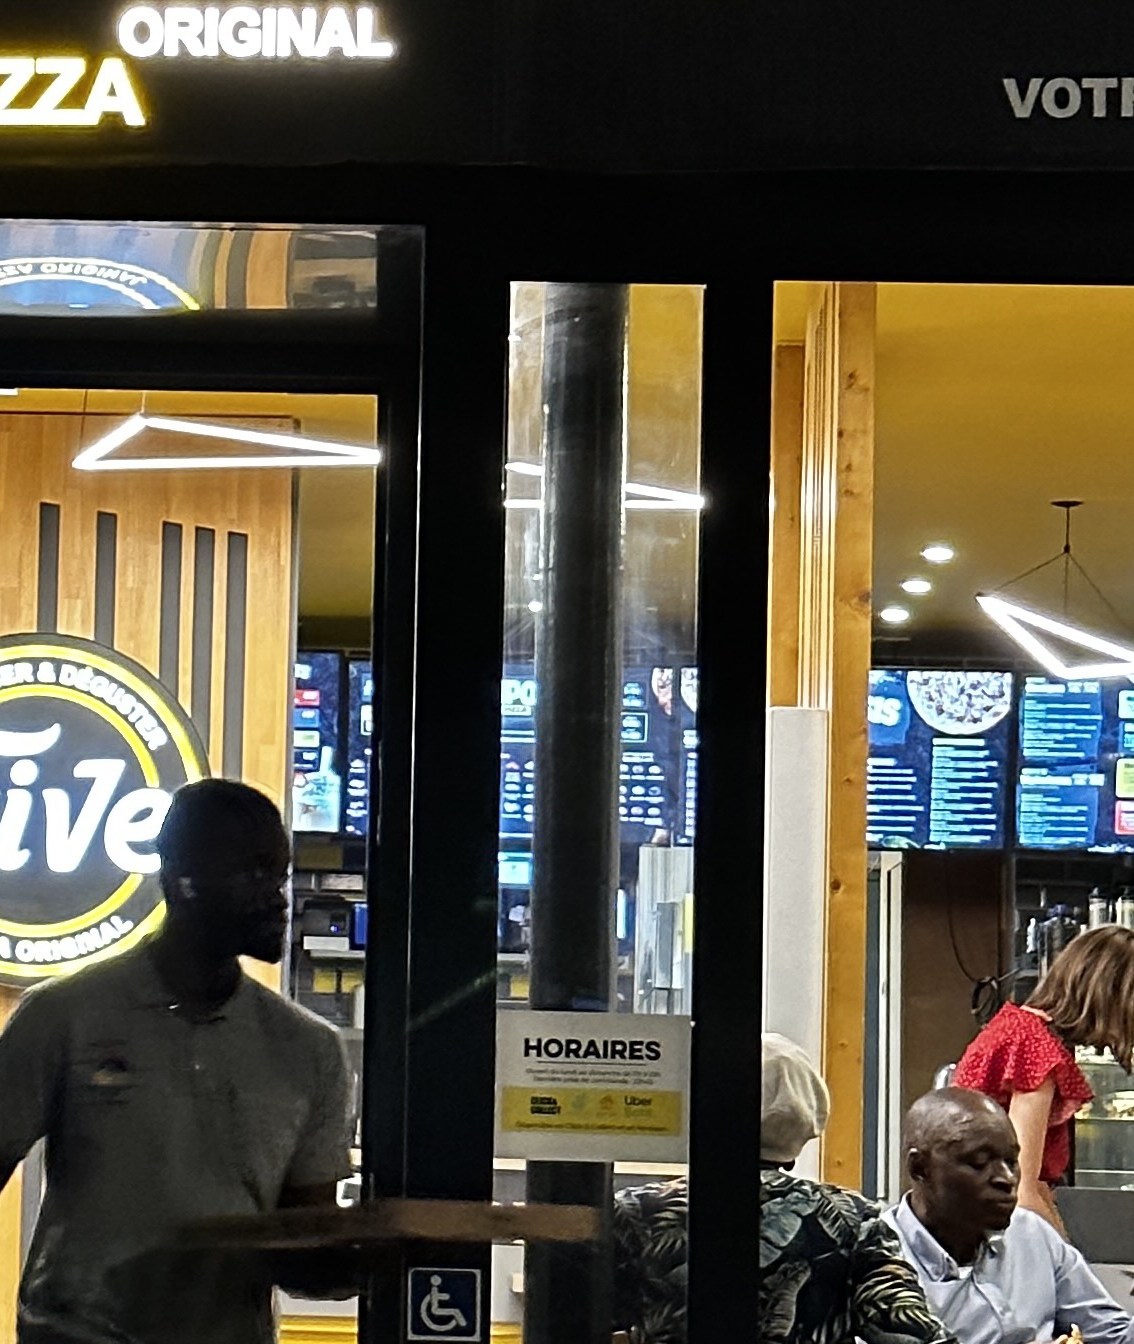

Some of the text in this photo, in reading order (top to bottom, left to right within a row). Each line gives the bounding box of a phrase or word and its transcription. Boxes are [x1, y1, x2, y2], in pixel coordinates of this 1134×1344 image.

[117, 5, 394, 58] ORIGINAL
[37, 661, 57, 683] &
[523, 1037, 662, 1061] HORAIRES
